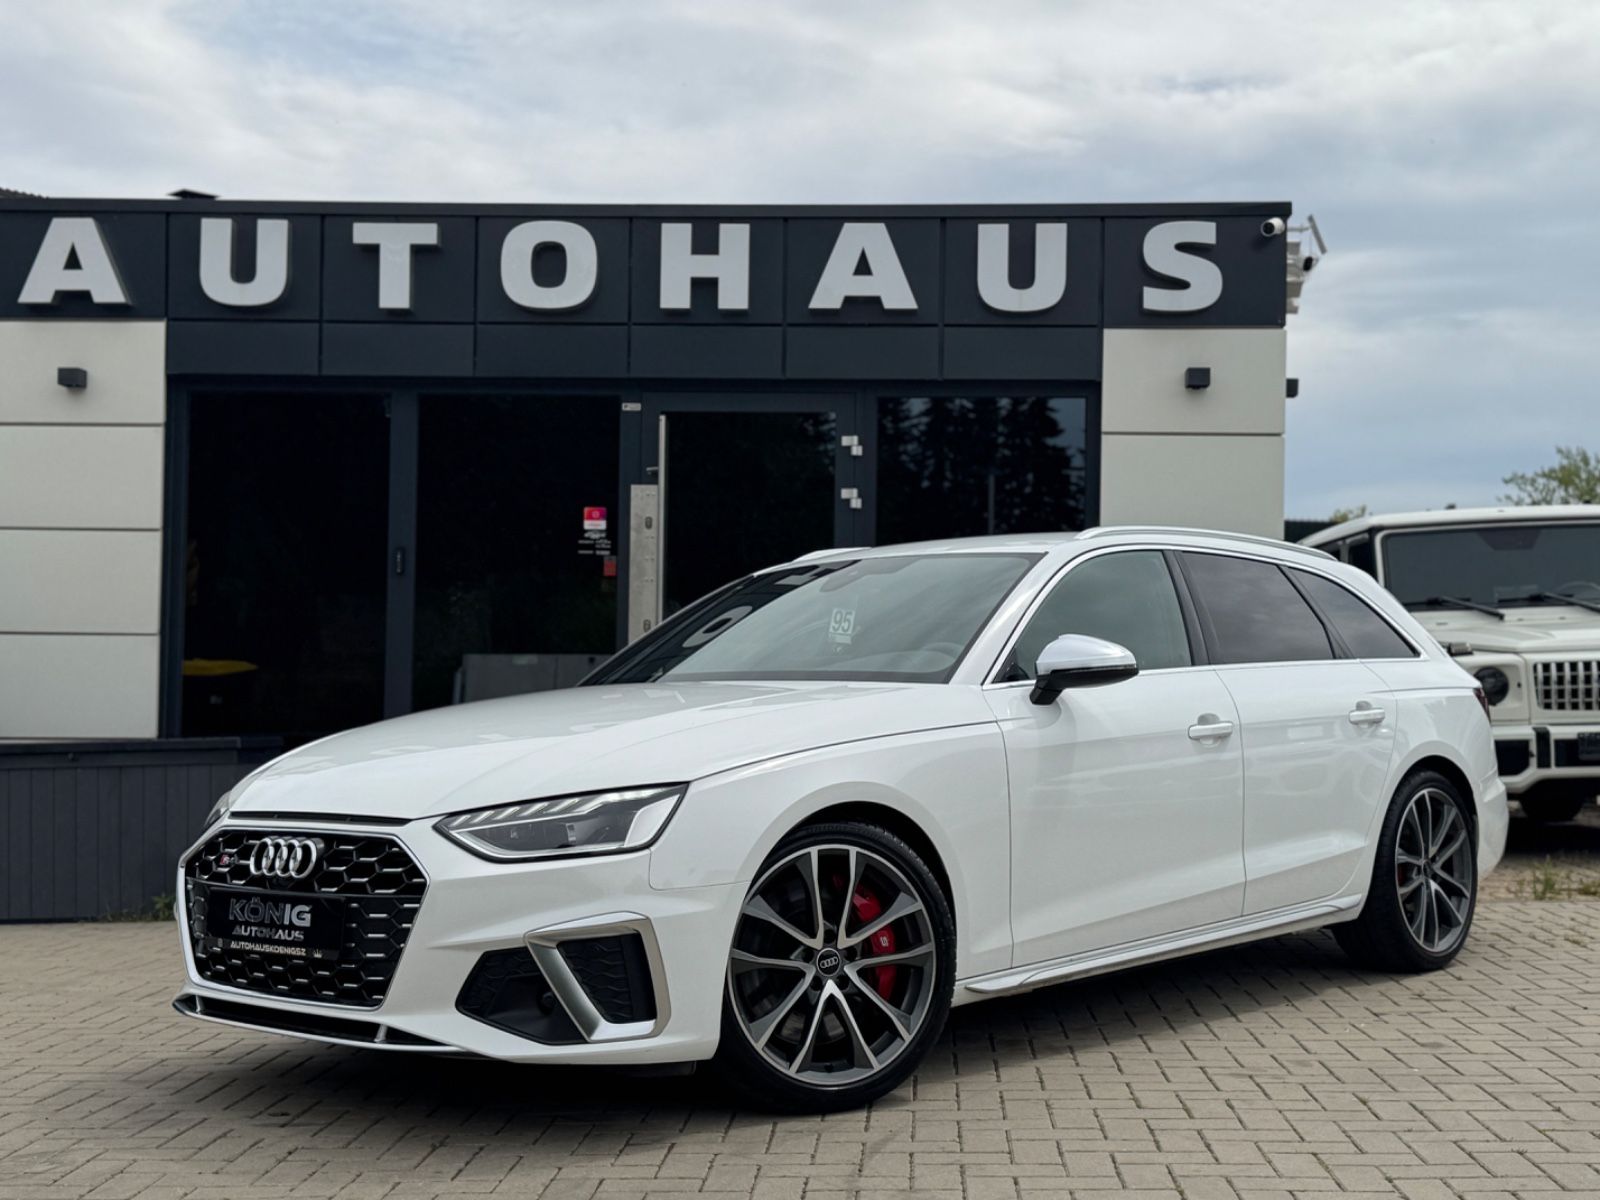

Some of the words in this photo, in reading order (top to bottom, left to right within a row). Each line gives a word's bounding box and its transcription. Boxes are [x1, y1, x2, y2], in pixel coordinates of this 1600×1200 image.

[17, 217, 1223, 312] AUTOHAUS
[832, 610, 853, 632] 95
[229, 897, 312, 927] KÖNIG
[231, 925, 305, 941] AUTOHAUS
